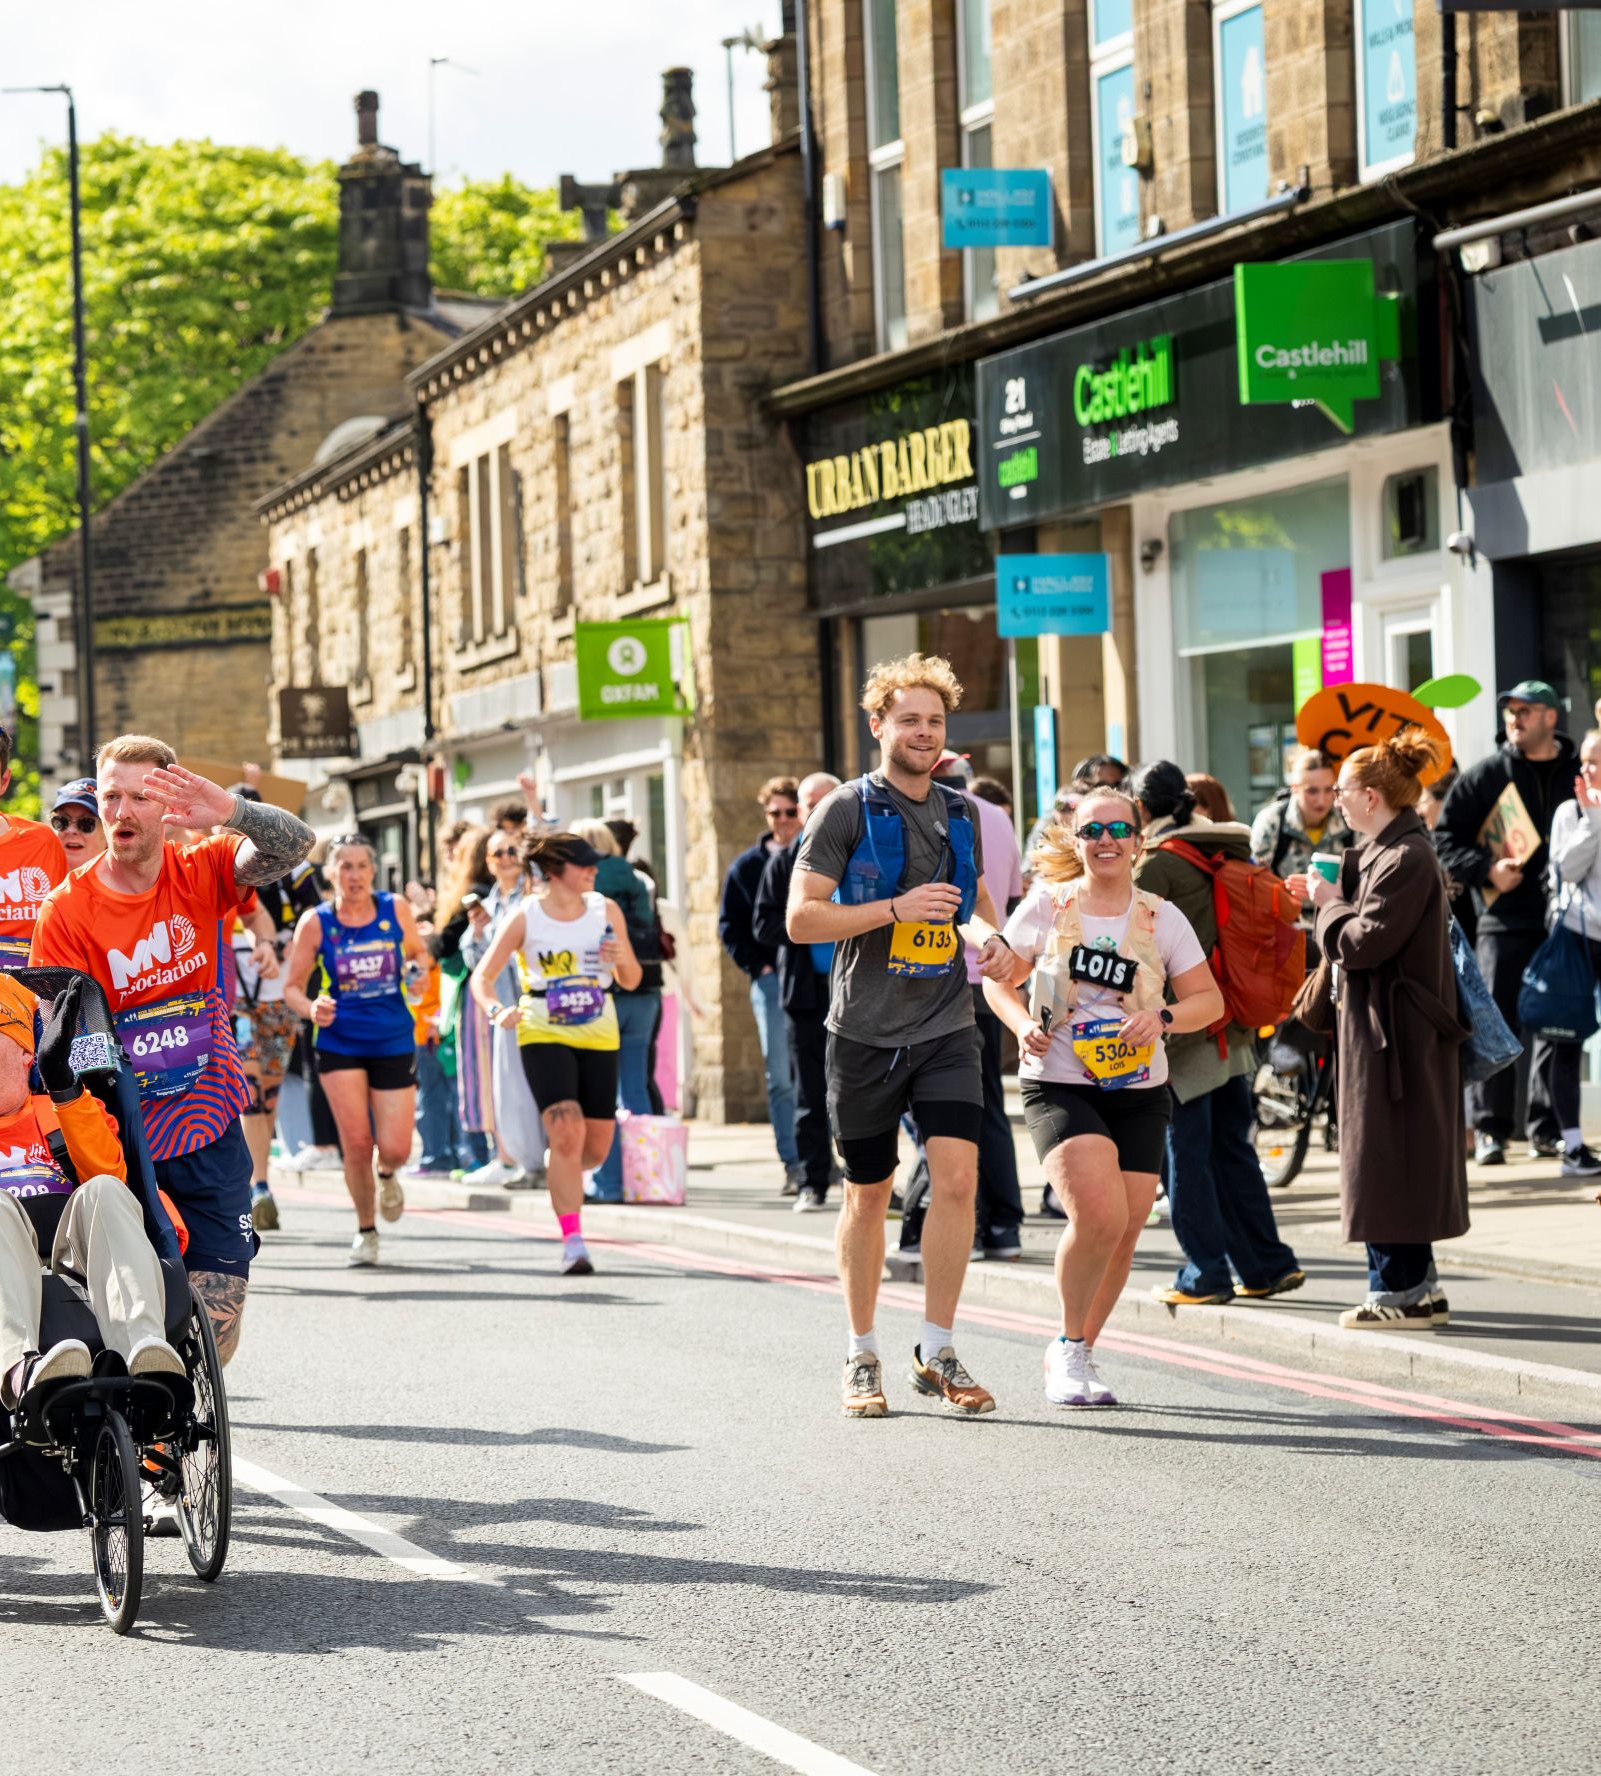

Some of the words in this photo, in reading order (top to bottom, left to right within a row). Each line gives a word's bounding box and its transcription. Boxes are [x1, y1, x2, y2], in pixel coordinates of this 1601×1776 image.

[1255, 338, 1369, 369] Castlehill
[1005, 376, 1026, 415] 21
[1073, 333, 1173, 428] Castlehill
[805, 442, 880, 520] URBAN
[600, 682, 659, 704] OXFAM
[107, 914, 196, 990] MND
[1075, 950, 1127, 986] LOIS
[132, 1025, 189, 1057] 6248
[1109, 1060, 1126, 1071] LOIS
